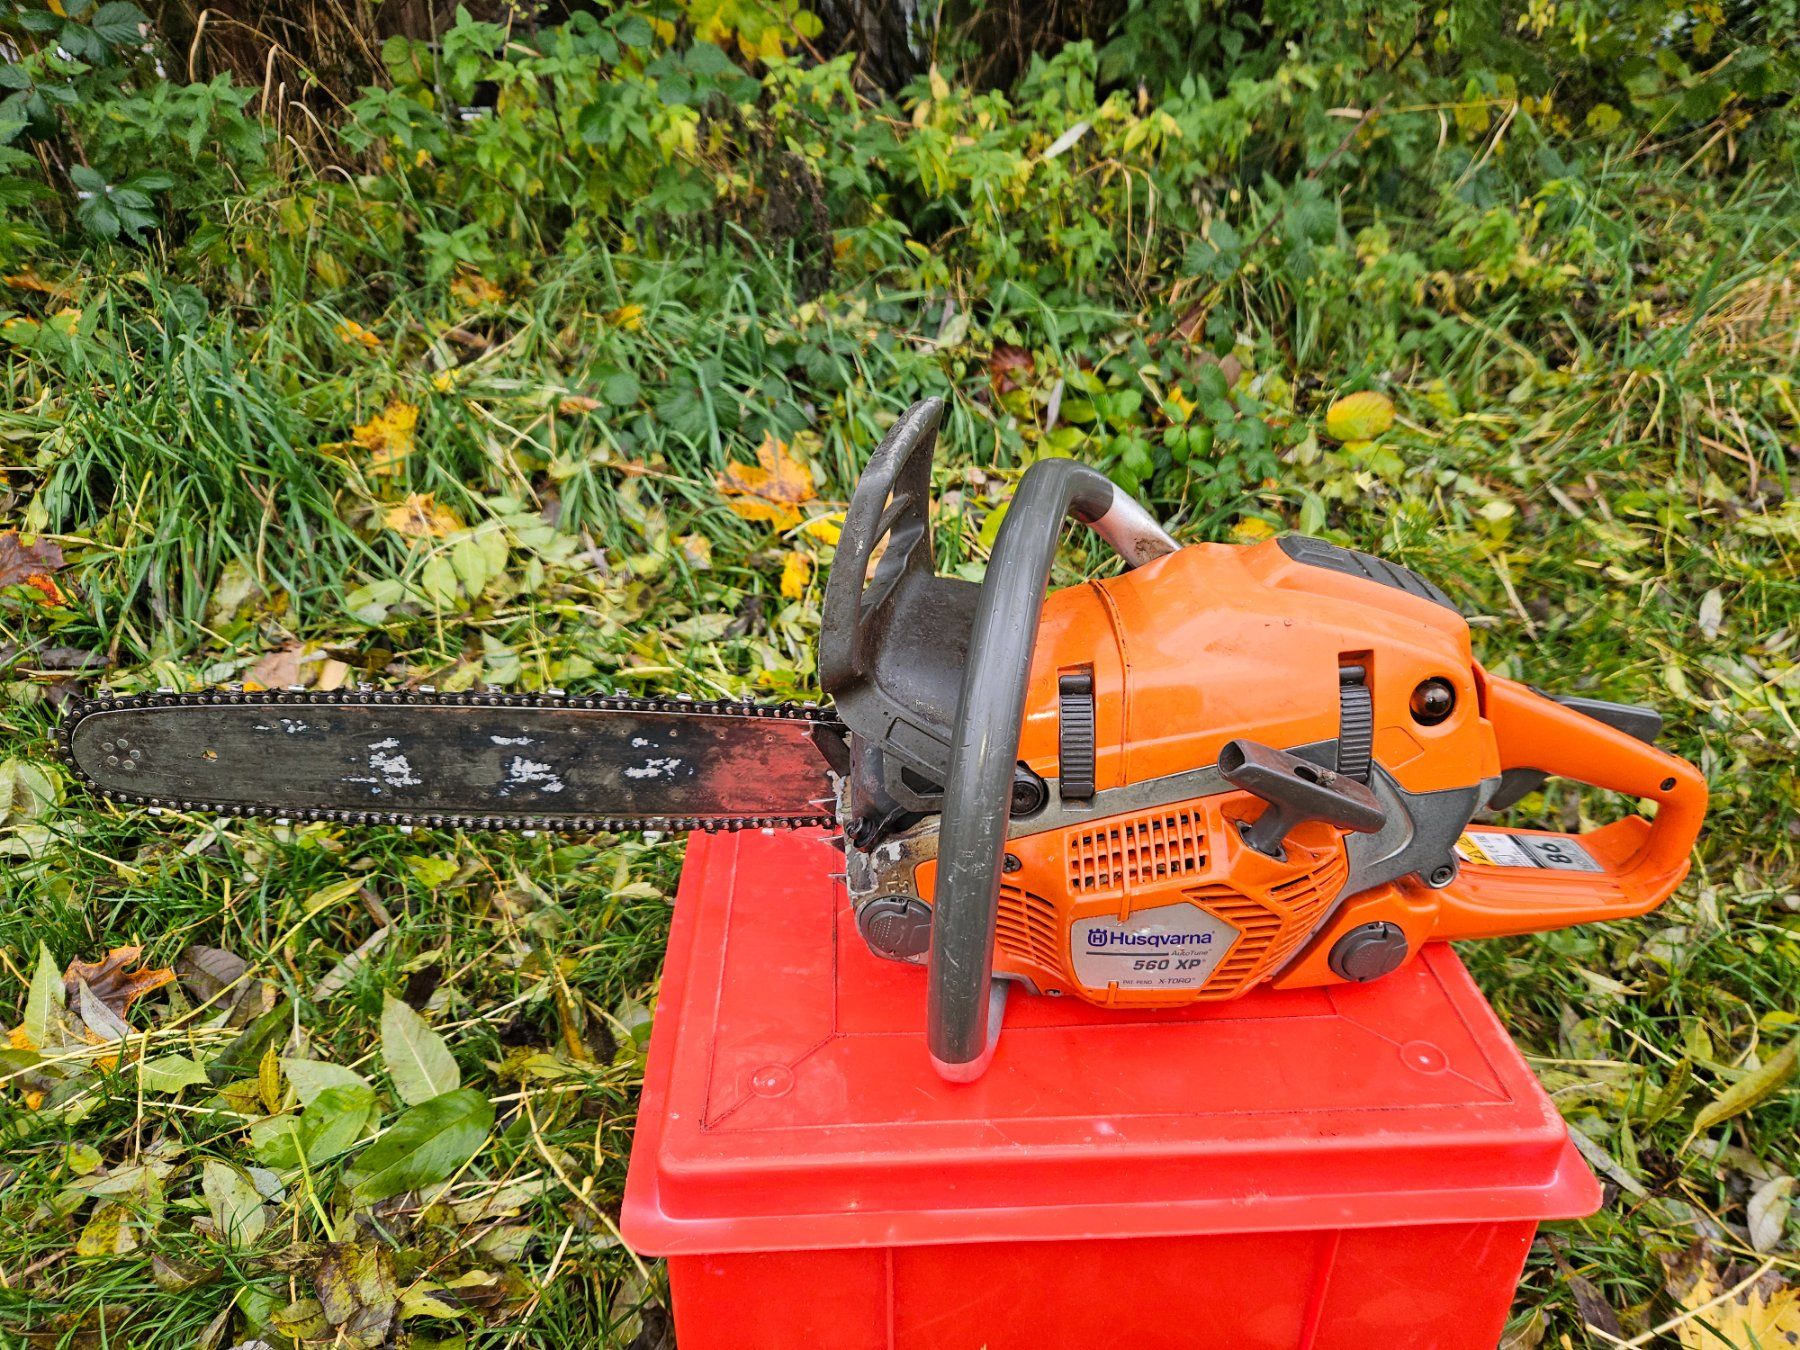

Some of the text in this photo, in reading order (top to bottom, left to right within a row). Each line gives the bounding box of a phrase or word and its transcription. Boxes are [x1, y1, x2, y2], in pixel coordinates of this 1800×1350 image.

[1110, 931, 1212, 947] Husqvarna
[1133, 959, 1202, 970] 560 XP
